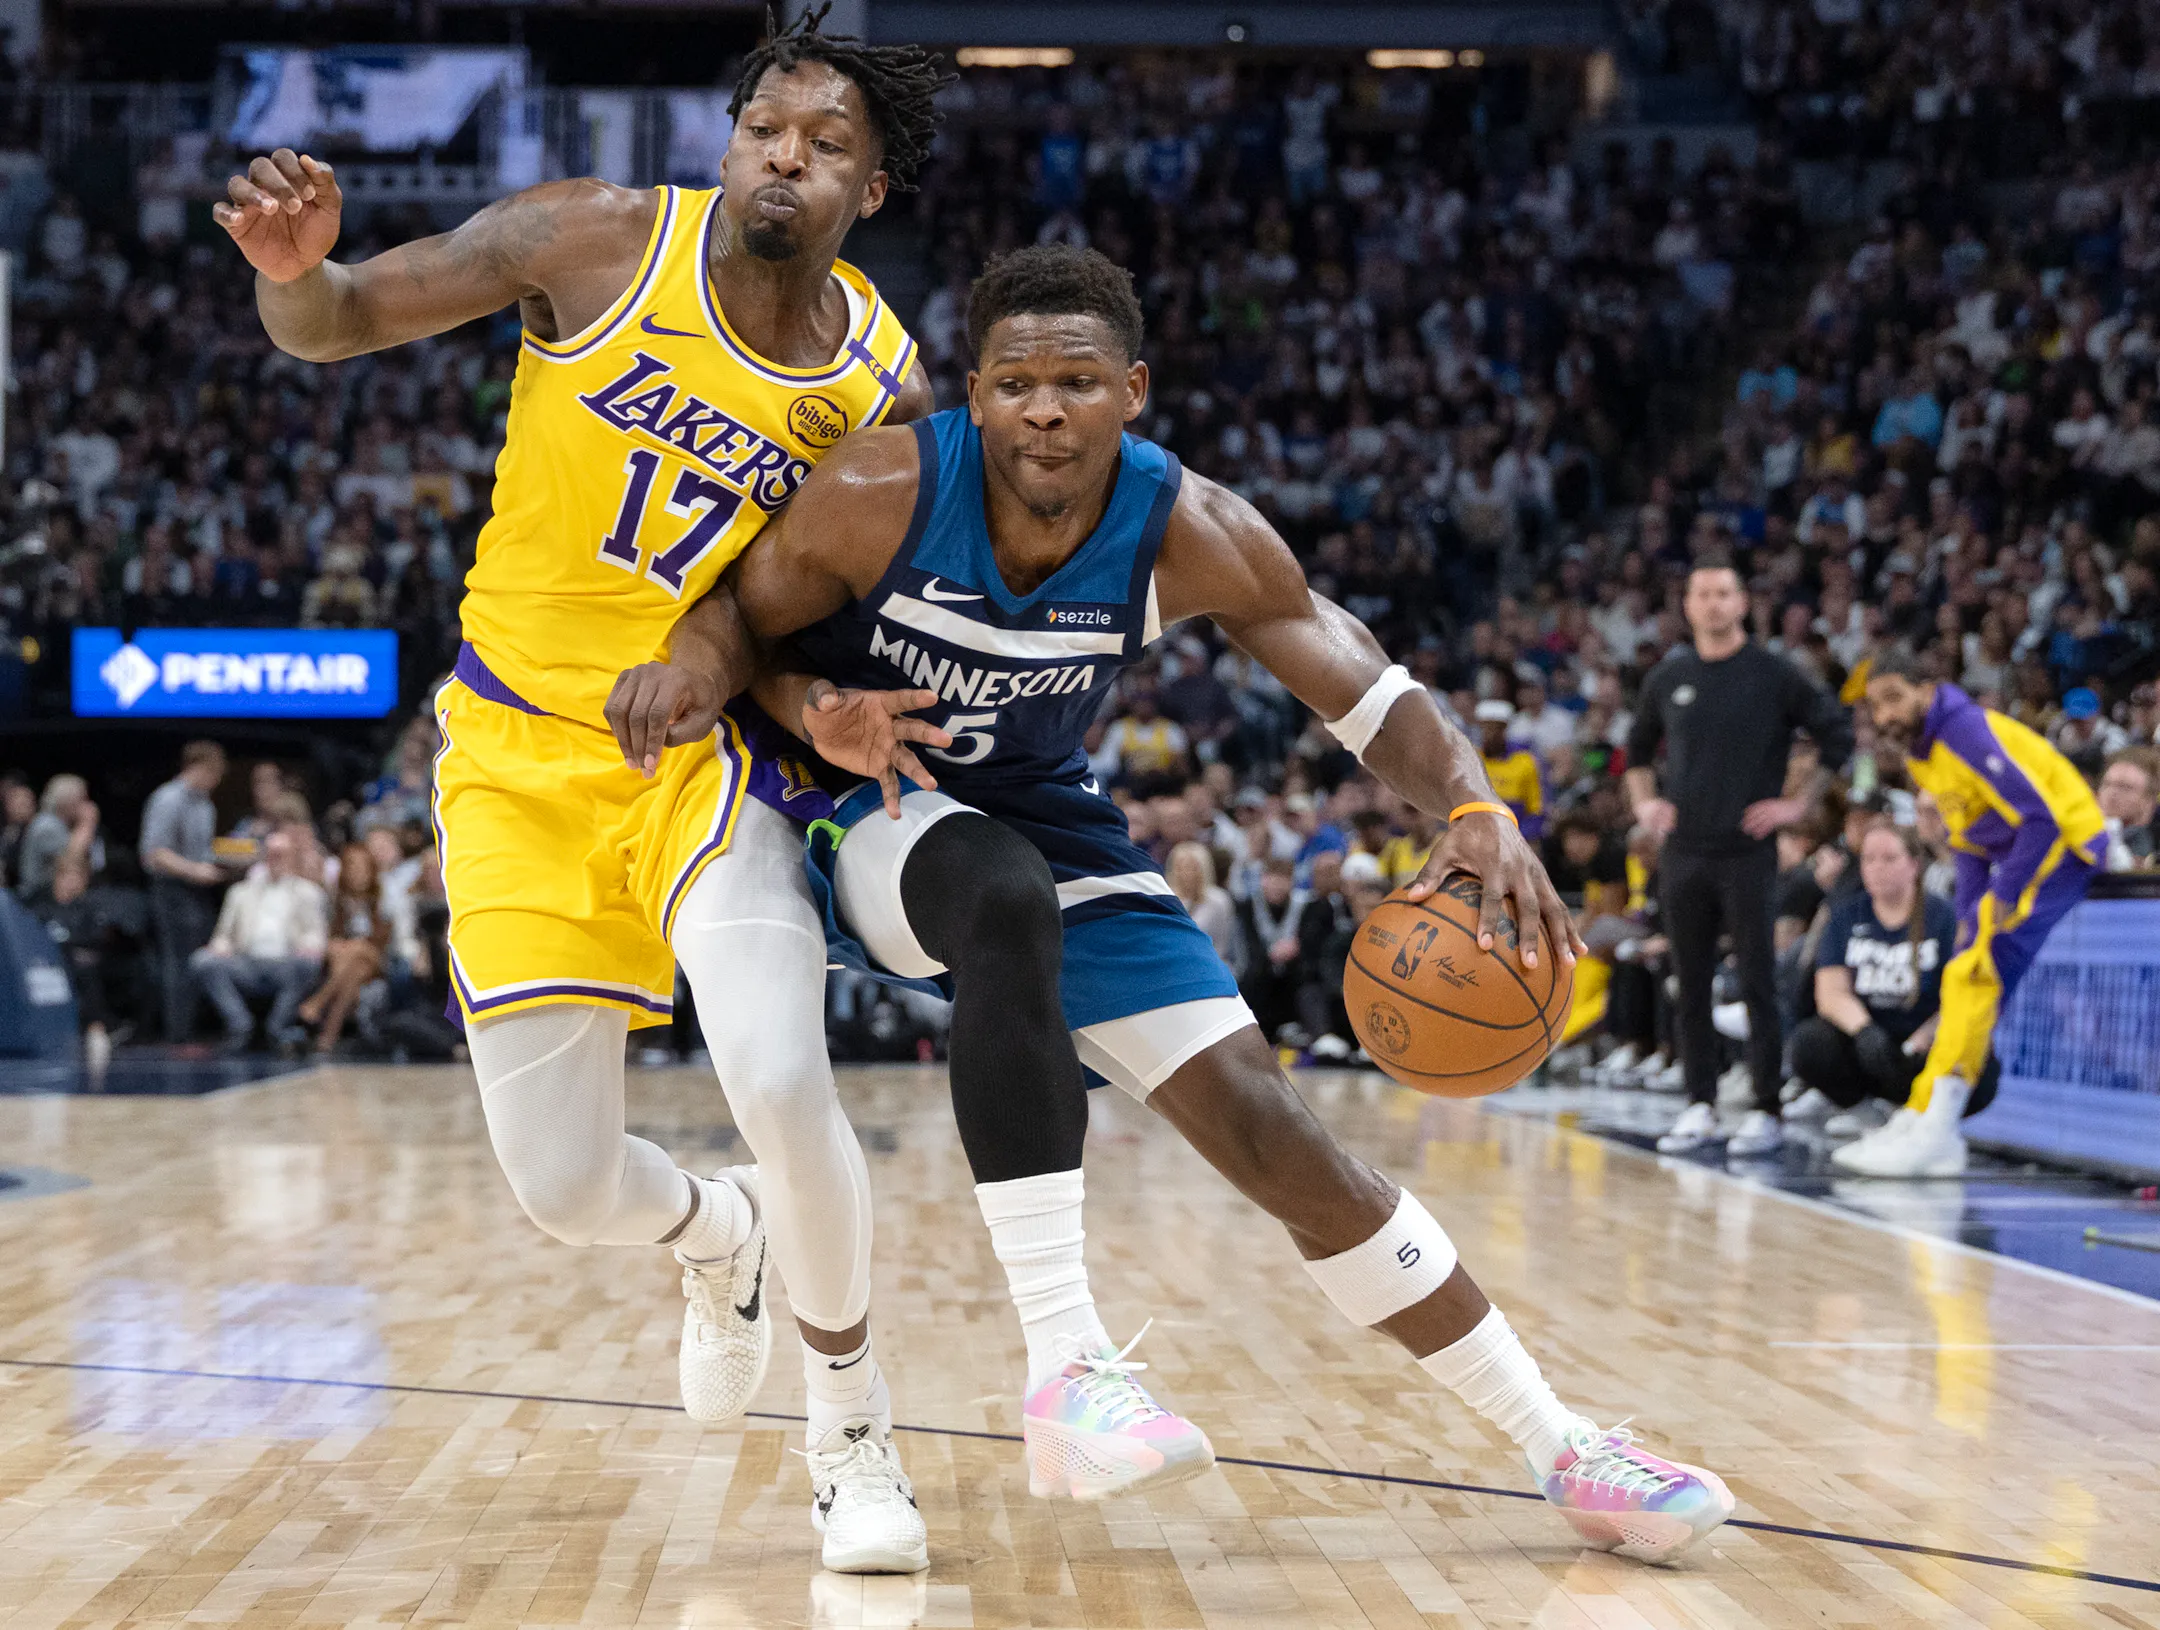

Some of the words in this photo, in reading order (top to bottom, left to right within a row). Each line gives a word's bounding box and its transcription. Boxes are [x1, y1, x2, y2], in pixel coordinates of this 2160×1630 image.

[575, 350, 812, 514] LAKERS
[795, 400, 842, 439] bibigo
[798, 419, 819, 437] 비비고
[596, 446, 750, 601] 17
[1057, 608, 1112, 625] sezzle
[161, 652, 370, 694] PENTAIR
[868, 624, 1095, 708] MINNESOTA
[925, 711, 998, 766] 5
[1396, 1241, 1421, 1269] 5
